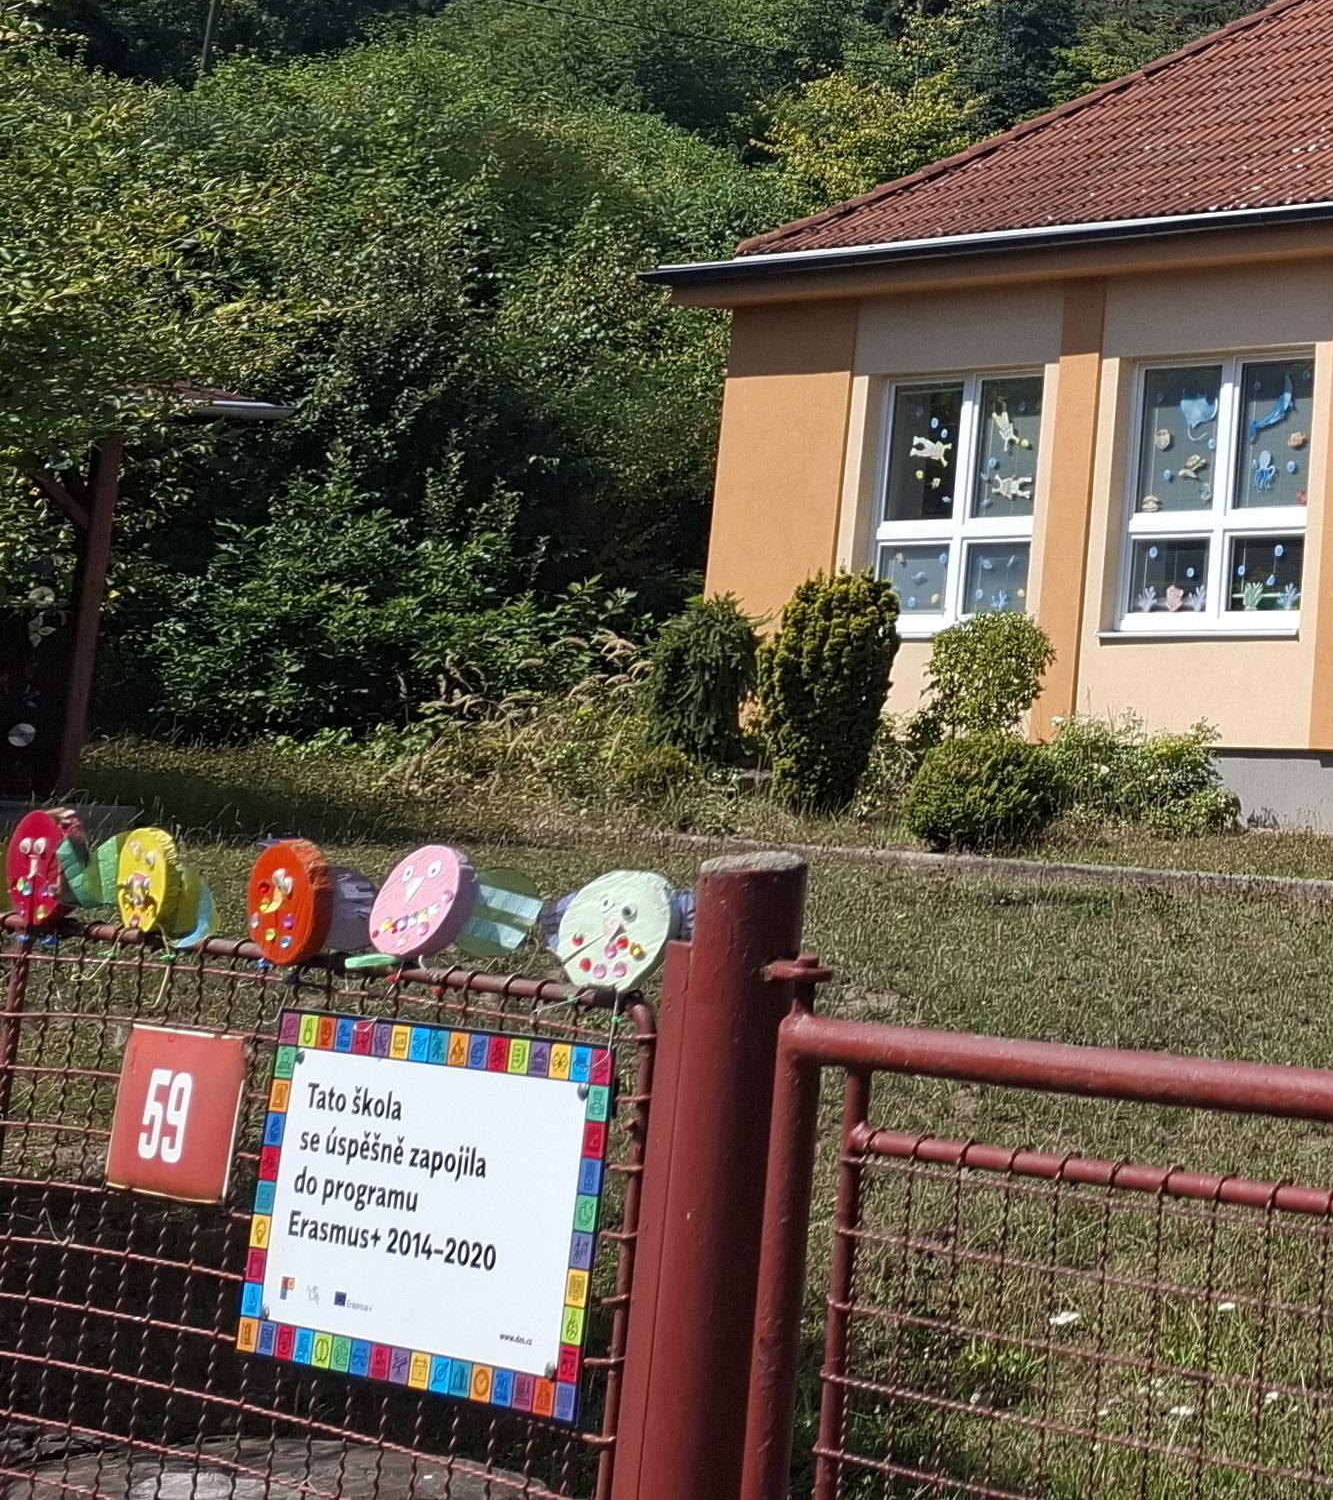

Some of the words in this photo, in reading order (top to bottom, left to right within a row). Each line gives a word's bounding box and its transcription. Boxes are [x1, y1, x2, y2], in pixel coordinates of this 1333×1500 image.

[138, 1068, 192, 1163] 59
[307, 1083, 346, 1113] Tato
[351, 1086, 402, 1121] škola
[299, 1131, 320, 1152] se
[325, 1127, 405, 1165] úspěšně
[408, 1146, 487, 1181] zapojila
[293, 1166, 318, 1196] do
[321, 1178, 419, 1212] programu
[287, 1210, 382, 1249] Erasmus+
